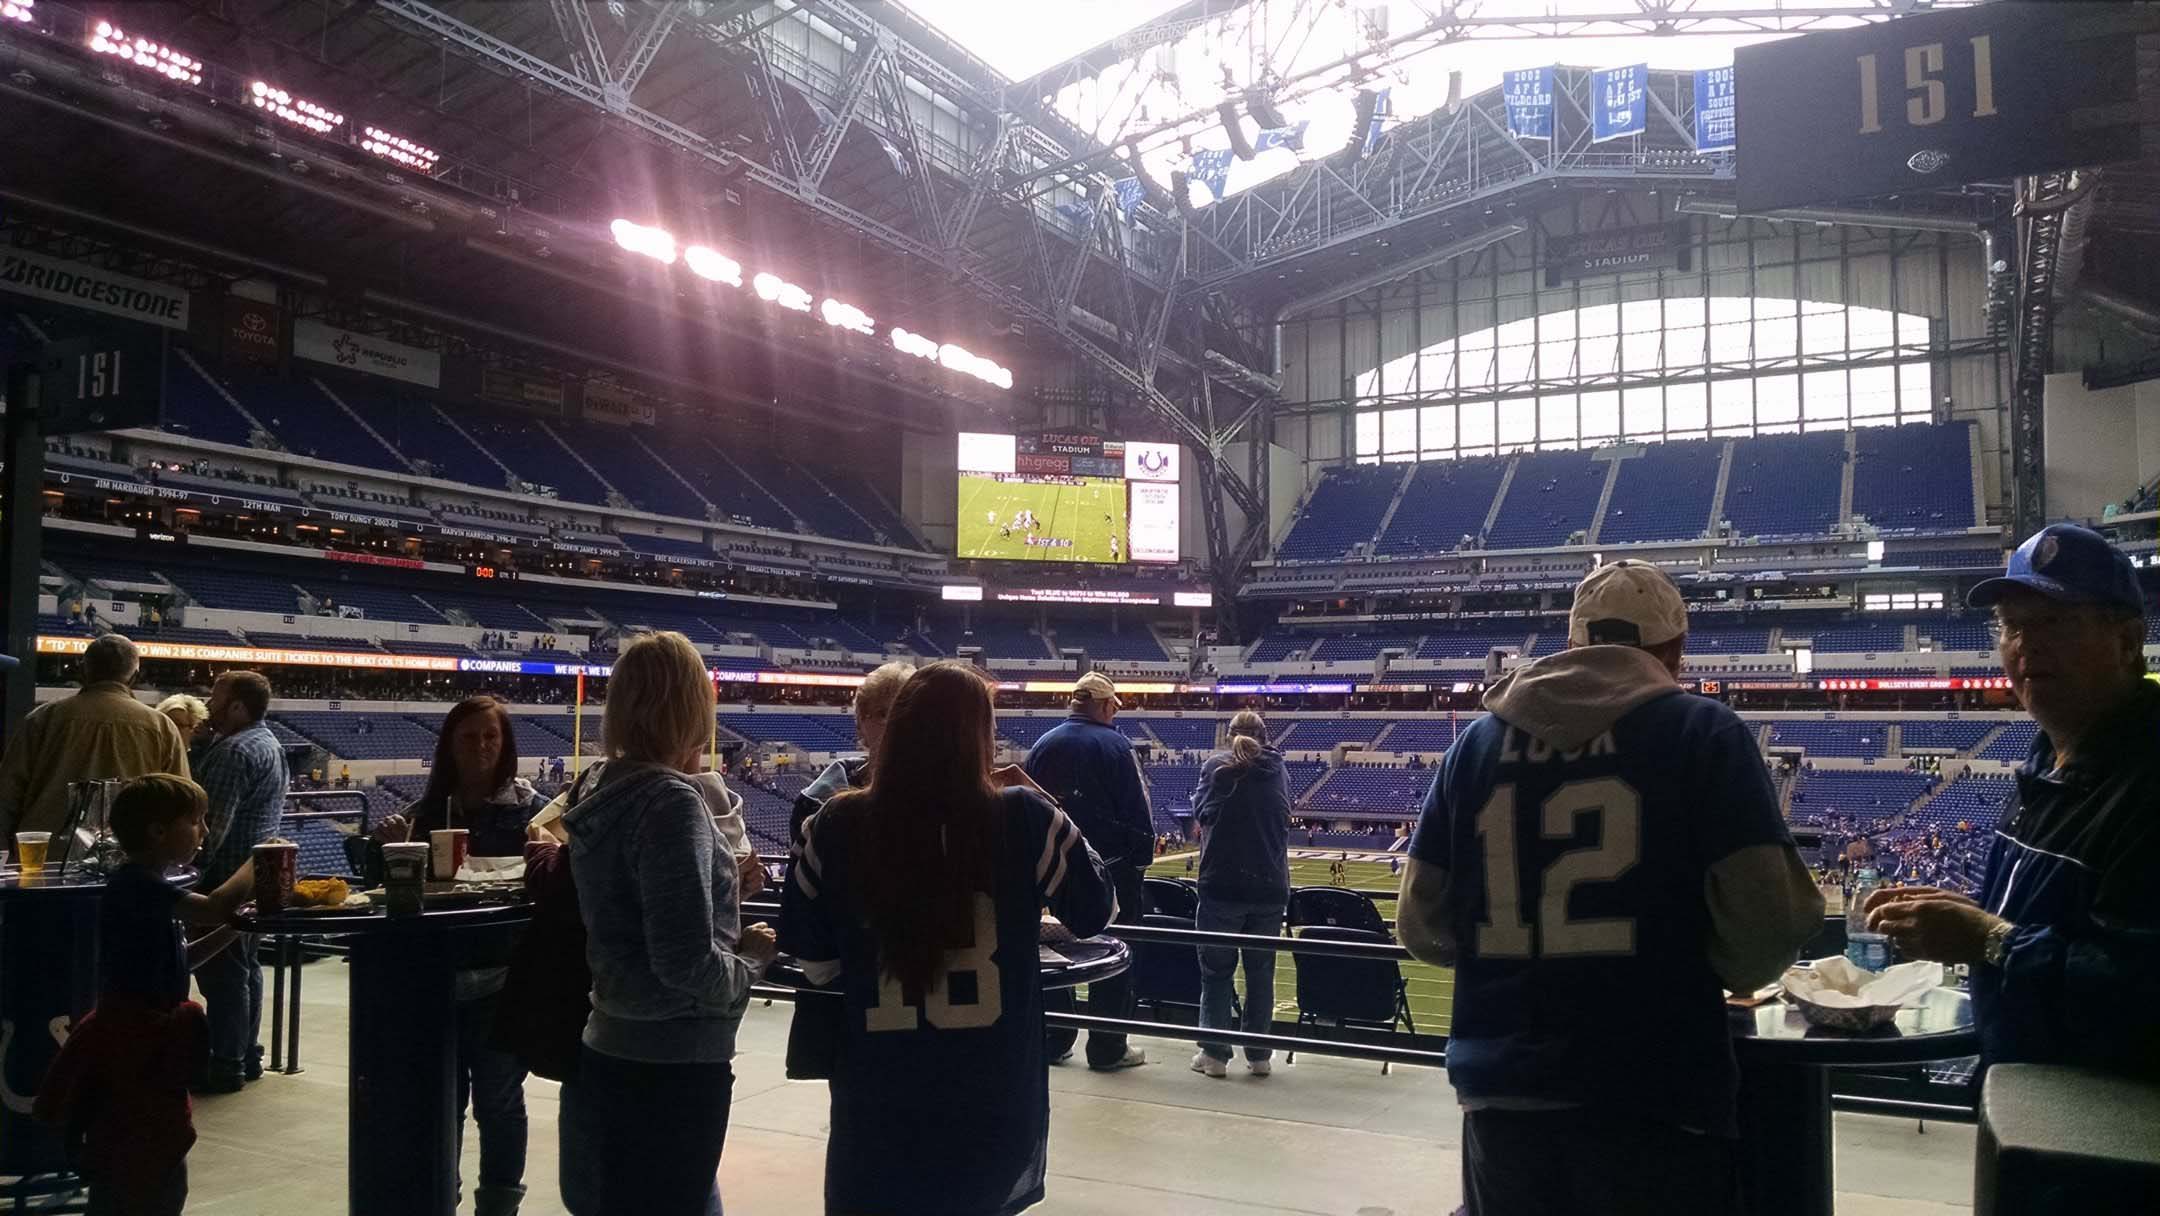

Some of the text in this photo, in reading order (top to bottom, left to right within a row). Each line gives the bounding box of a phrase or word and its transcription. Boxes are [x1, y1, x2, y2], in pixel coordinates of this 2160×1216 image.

[1857, 35, 1998, 135] 151
[1584, 253, 1648, 269] STADIUM
[1, 255, 183, 320] BRIDGESTONE
[232, 327, 276, 346] TOYOTA
[361, 348, 408, 366] REPUBLIC
[77, 350, 120, 399] 151
[1042, 433, 1100, 446] LUCAS OIL
[1052, 444, 1090, 454] STADIUM
[1017, 455, 1070, 472] hhgregg
[95, 479, 188, 500] JIM HARBAUGH 1994-97
[243, 500, 281, 513] 12TH MAN
[330, 511, 348, 522] TONY
[349, 513, 373, 525] DUNGY
[148, 532, 176, 543] verizon
[476, 567, 494, 578] 0:00
[151, 645, 172, 656] WIN
[173, 646, 180, 656] 2
[181, 647, 197, 657] MS
[198, 647, 253, 660] COMPANIES
[256, 651, 282, 661] SUITE
[285, 652, 319, 663] TICKETS
[321, 654, 333, 663] TO
[335, 655, 353, 664] THE
[355, 656, 376, 665] NEXT
[405, 658, 430, 667] HOME
[471, 660, 521, 673] COMPANIES
[554, 665, 568, 675] WE
[588, 666, 601, 676] WE
[717, 672, 756, 682] COMPANIES
[1878, 681, 1951, 689] BULLSEYE EVENT GROUP
[1474, 778, 1641, 958] 12
